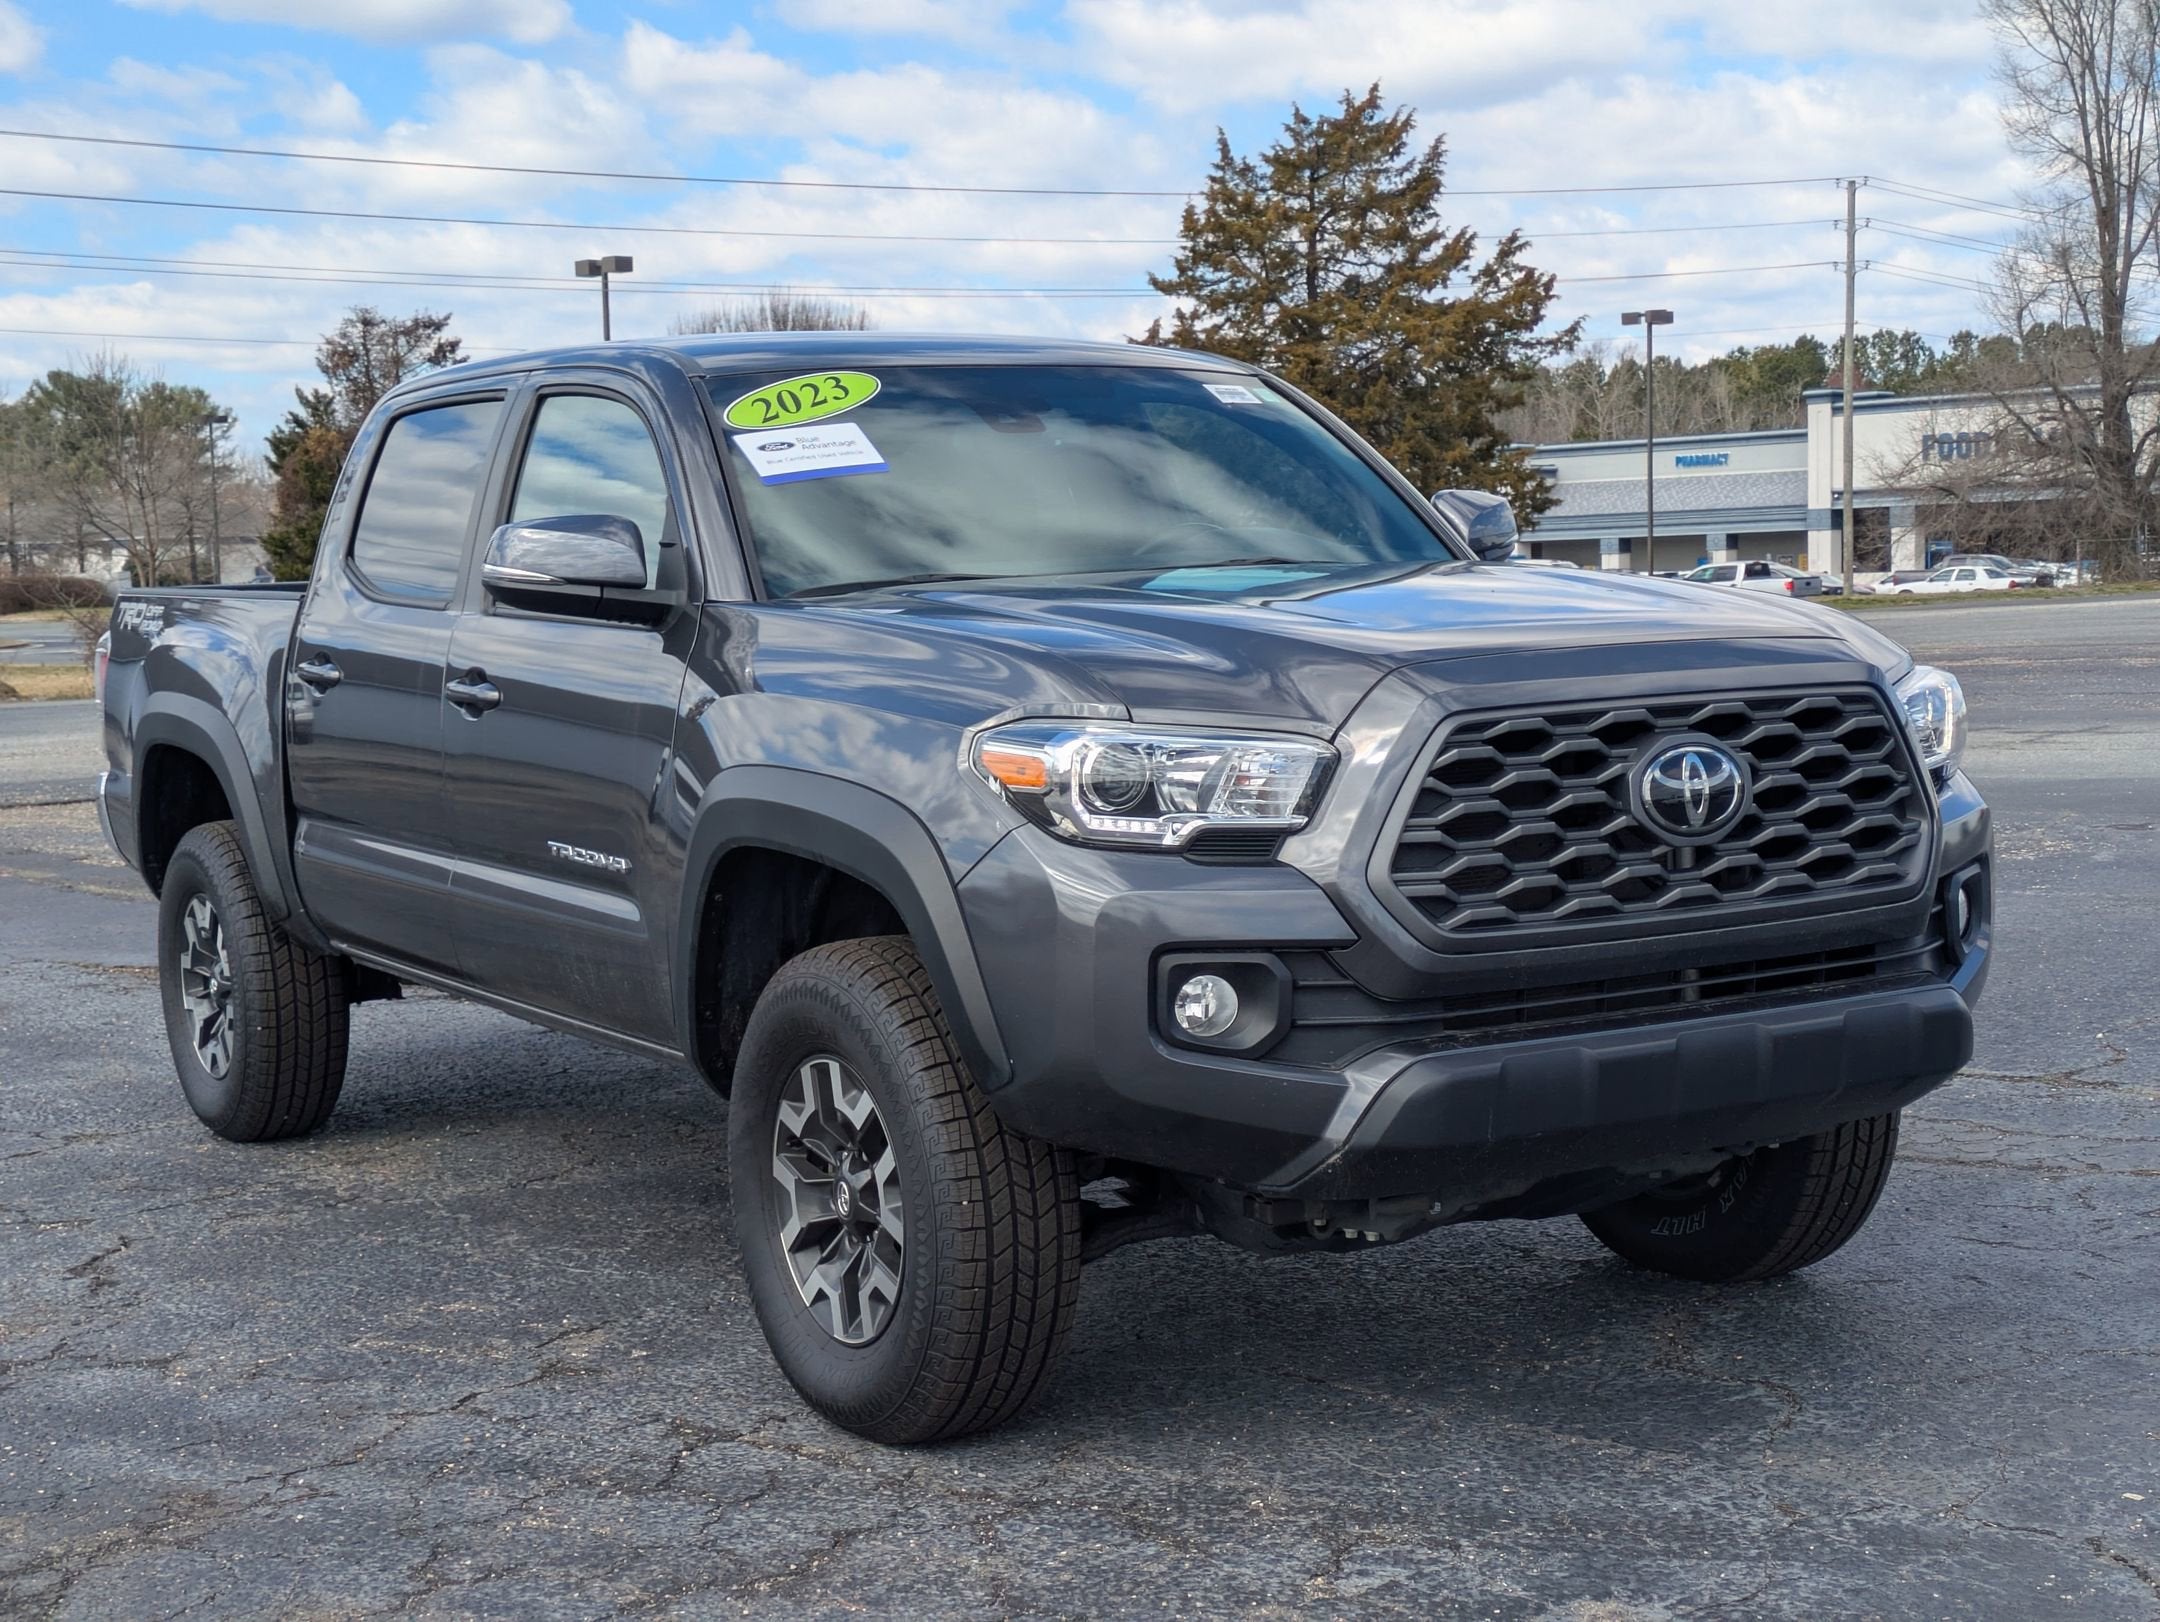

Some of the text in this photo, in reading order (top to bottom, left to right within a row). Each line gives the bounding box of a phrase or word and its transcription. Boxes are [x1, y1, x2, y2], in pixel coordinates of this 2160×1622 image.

[751, 376, 849, 424] 2023
[801, 440, 856, 451] Advantage
[547, 841, 633, 874] TACOMA
